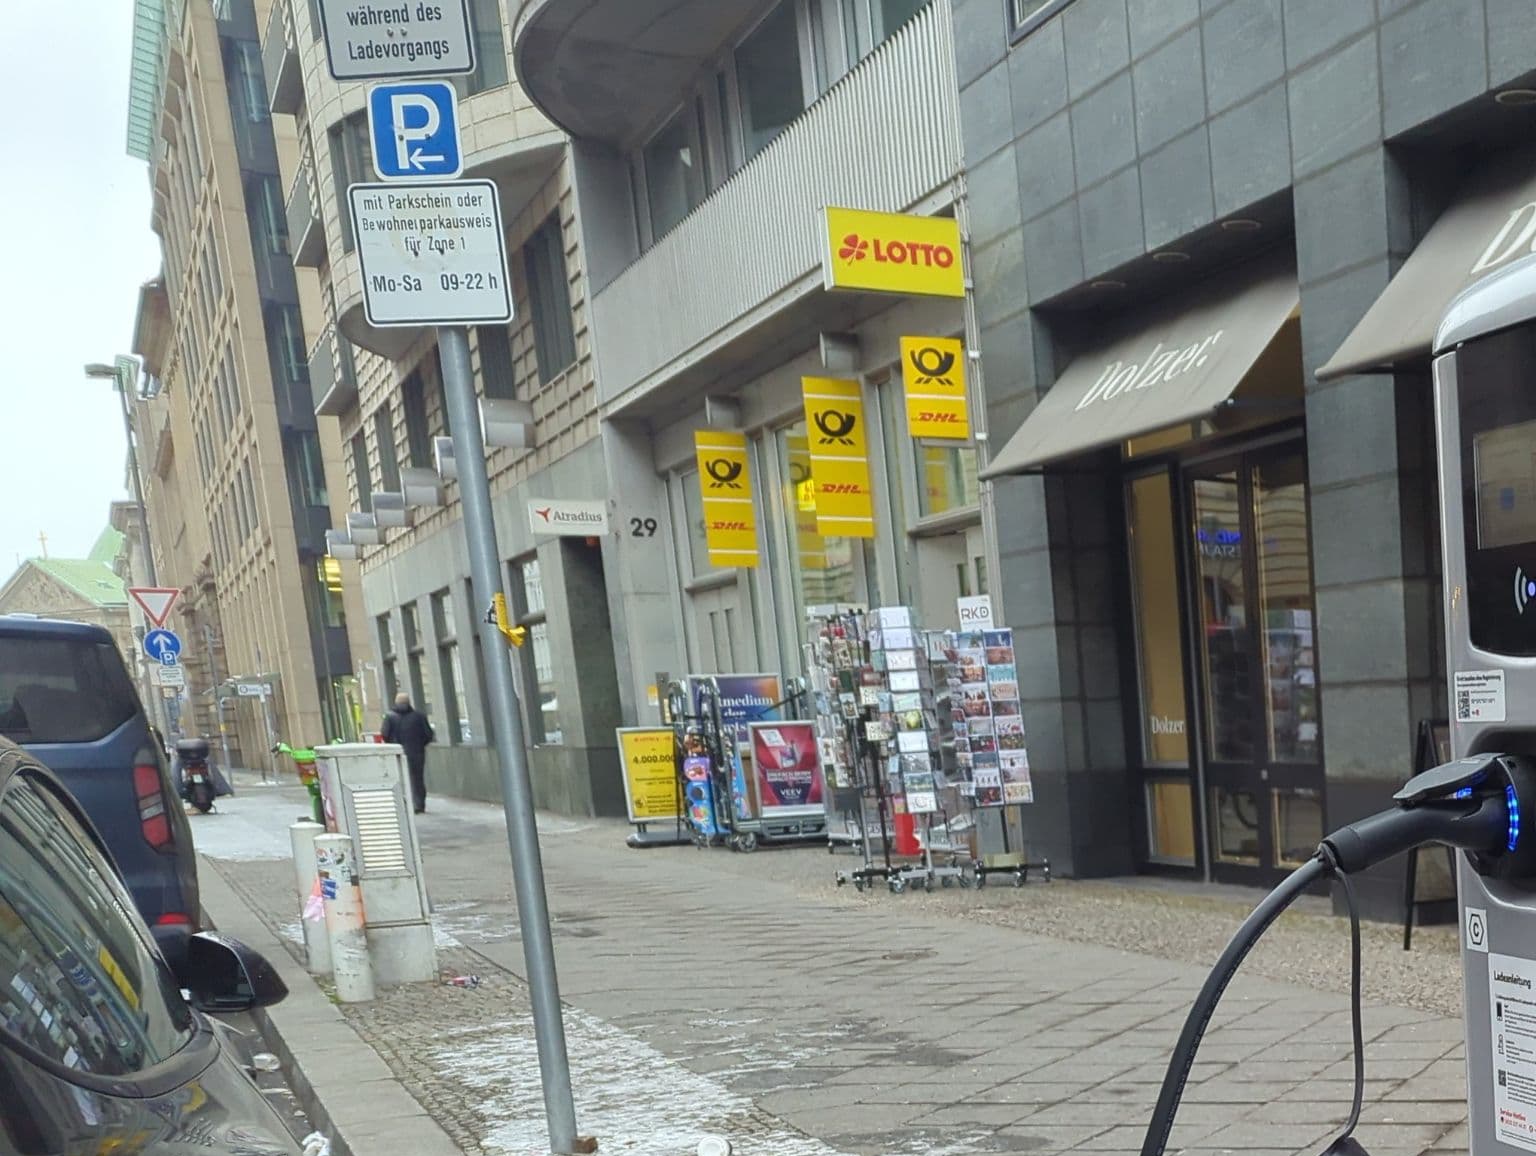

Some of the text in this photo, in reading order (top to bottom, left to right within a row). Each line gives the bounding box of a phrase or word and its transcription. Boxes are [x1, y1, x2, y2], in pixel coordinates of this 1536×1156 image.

[346, 1, 442, 26] während des
[348, 39, 449, 61] Ladevorgangs
[390, 93, 440, 169] P
[363, 191, 483, 210] mit Parkschein oder
[404, 235, 466, 252] für Zone 1
[873, 238, 954, 269] LOTTO
[372, 272, 498, 292] Mo-Sa 09-22 h
[918, 412, 961, 424] DHL
[820, 483, 862, 495] DHL
[553, 511, 603, 522] Atradius
[711, 521, 746, 531] DHL
[630, 517, 658, 538] 29
[1151, 715, 1185, 735] Dolzer
[1494, 970, 1532, 990] Ladeanleitung
